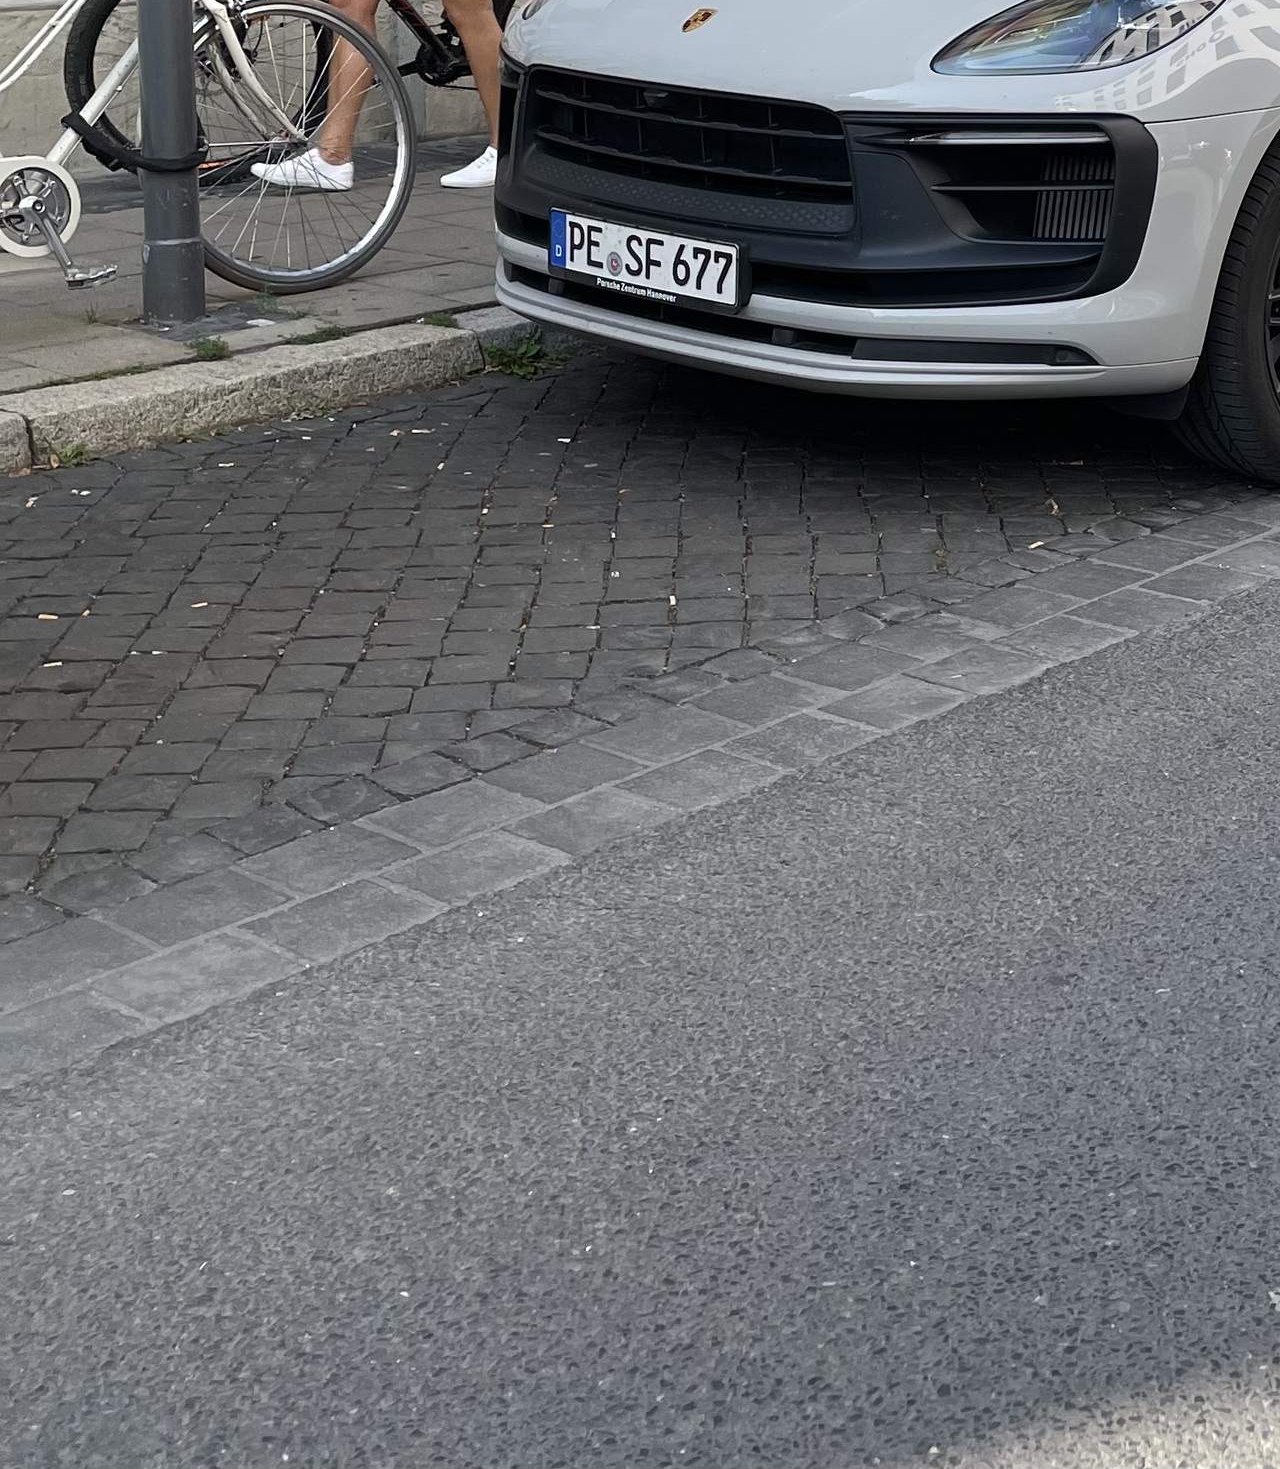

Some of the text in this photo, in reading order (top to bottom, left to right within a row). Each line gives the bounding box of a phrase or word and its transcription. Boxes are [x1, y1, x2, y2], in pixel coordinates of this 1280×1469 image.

[555, 244, 563, 258] D
[568, 220, 733, 295] PE SF 677
[596, 277, 677, 303] Porsche Zentrum Hannover
